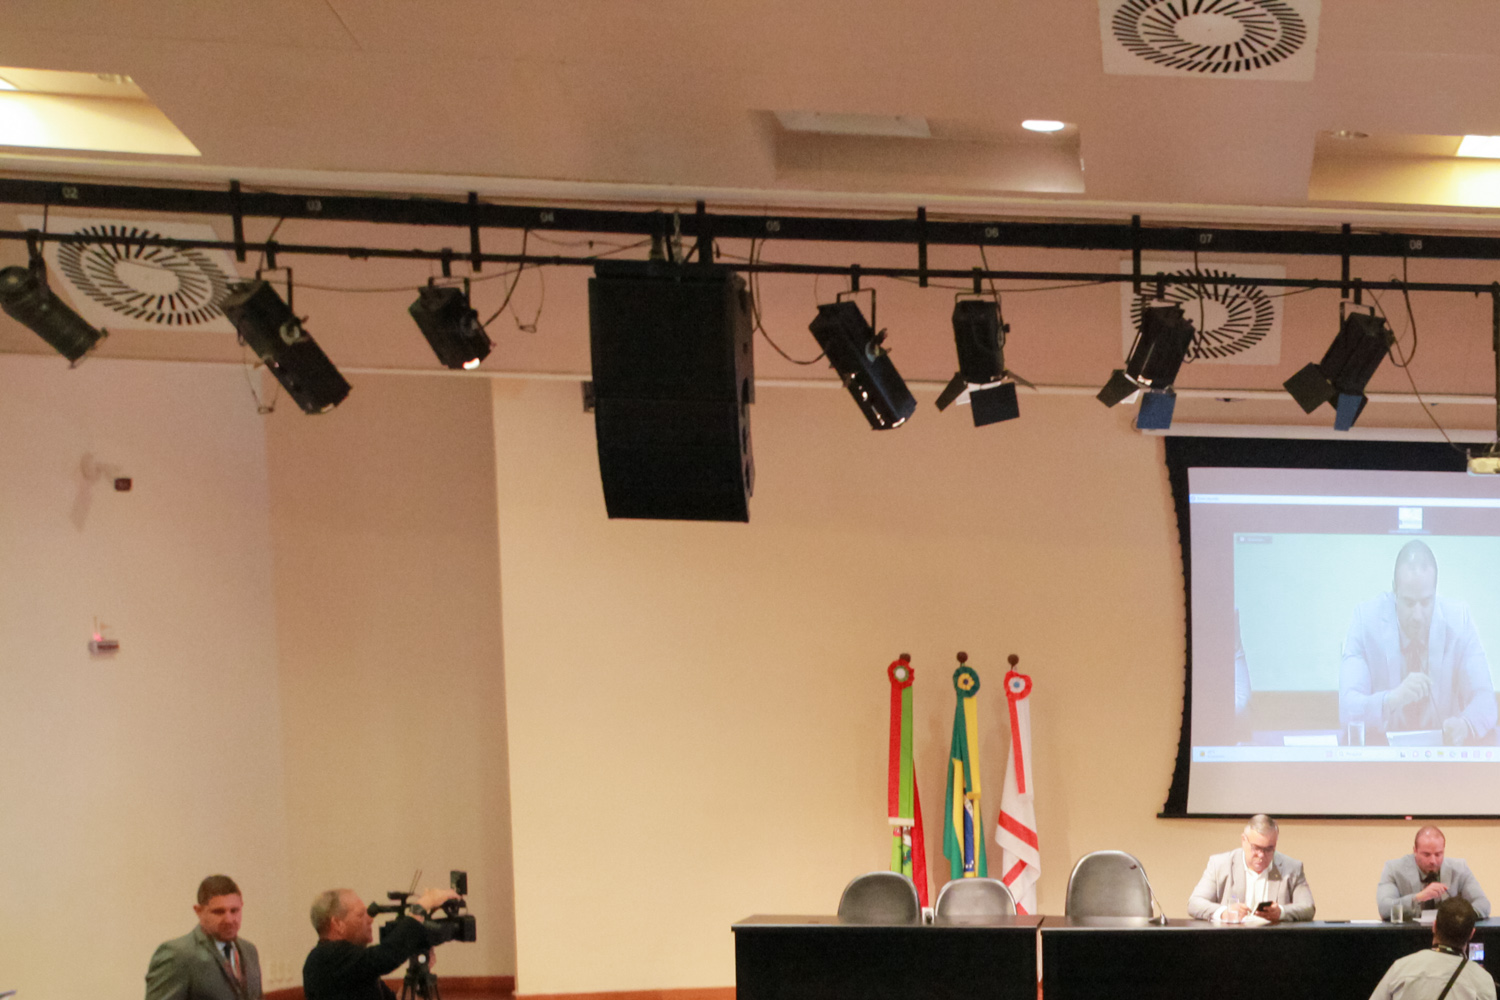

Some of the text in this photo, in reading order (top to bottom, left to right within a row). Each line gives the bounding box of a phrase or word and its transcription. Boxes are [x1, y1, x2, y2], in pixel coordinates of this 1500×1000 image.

[61, 186, 78, 199] 02
[306, 199, 322, 212] 03
[539, 211, 555, 223] 04
[766, 220, 781, 232] 05
[985, 227, 1000, 239] 06
[1199, 233, 1213, 244] 07
[1409, 239, 1423, 250] 08
